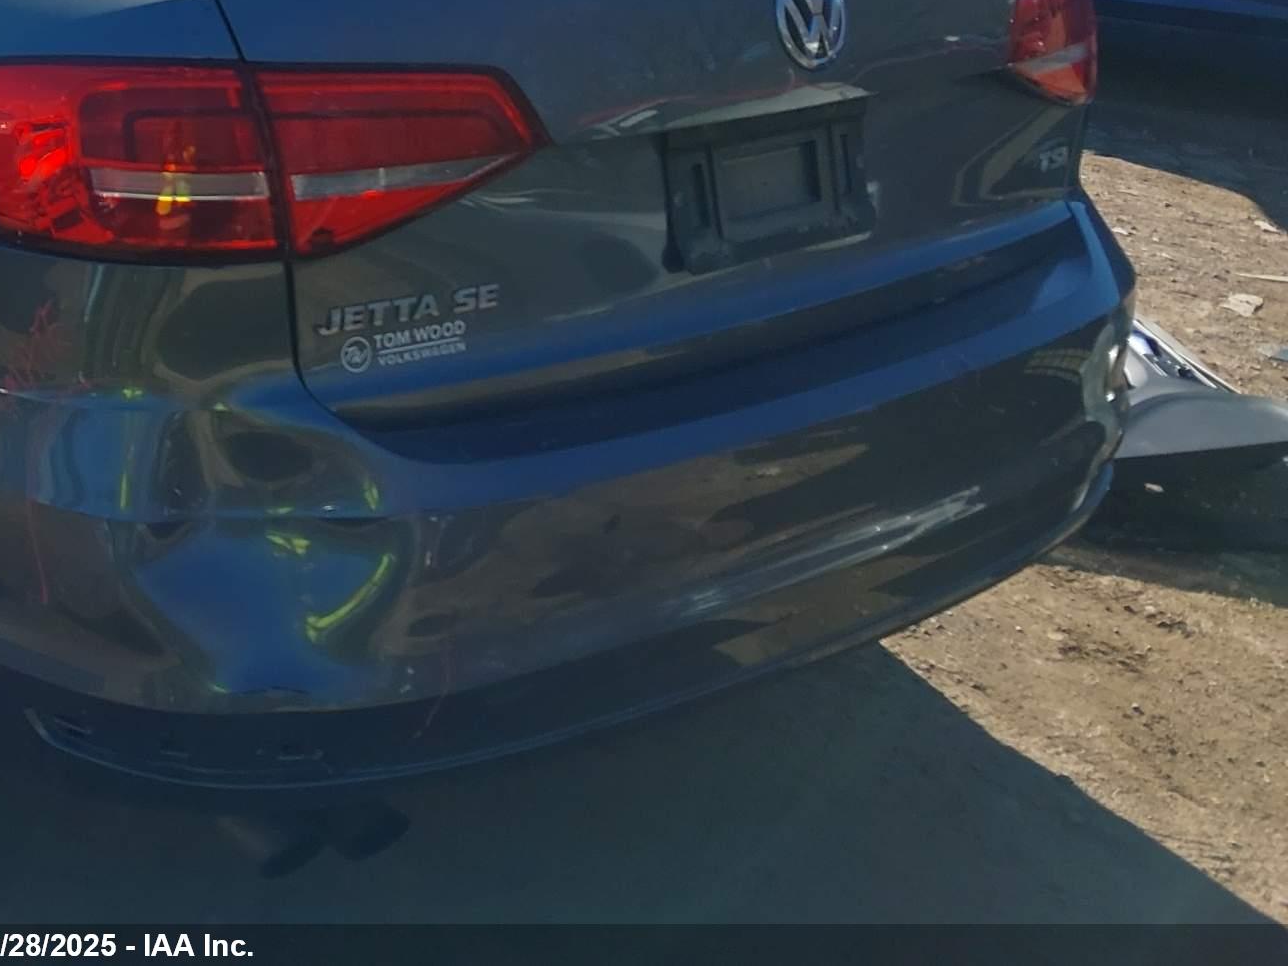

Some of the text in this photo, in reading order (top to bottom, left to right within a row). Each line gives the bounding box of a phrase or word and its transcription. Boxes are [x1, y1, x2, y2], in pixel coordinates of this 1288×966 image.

[317, 284, 500, 335] JETTA SE
[373, 320, 466, 349] TOM WOOD
